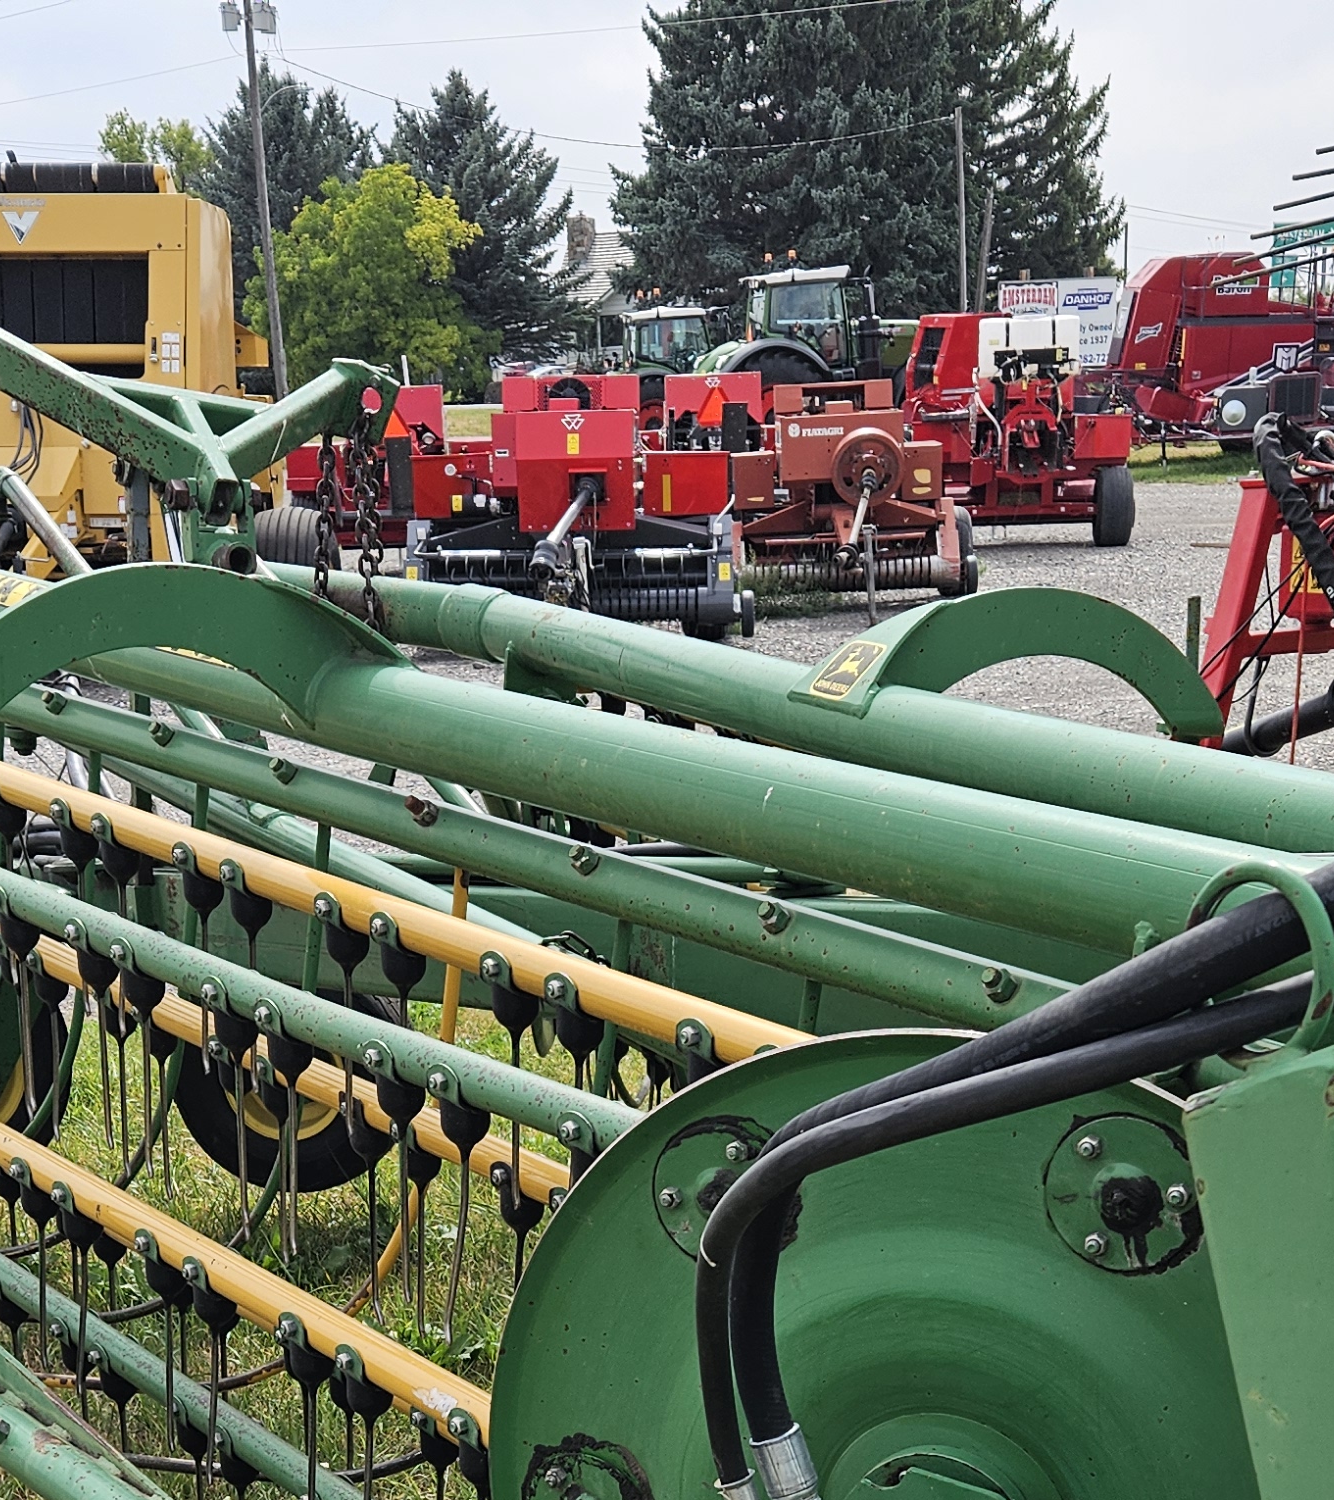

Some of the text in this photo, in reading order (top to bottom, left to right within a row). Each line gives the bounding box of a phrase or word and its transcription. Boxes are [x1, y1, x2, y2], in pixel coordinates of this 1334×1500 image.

[1002, 287, 1056, 310] AMSTERDAM
[1065, 294, 1110, 304] DANHOF
[1088, 322, 1113, 332] Owned
[1090, 335, 1108, 345] 1937
